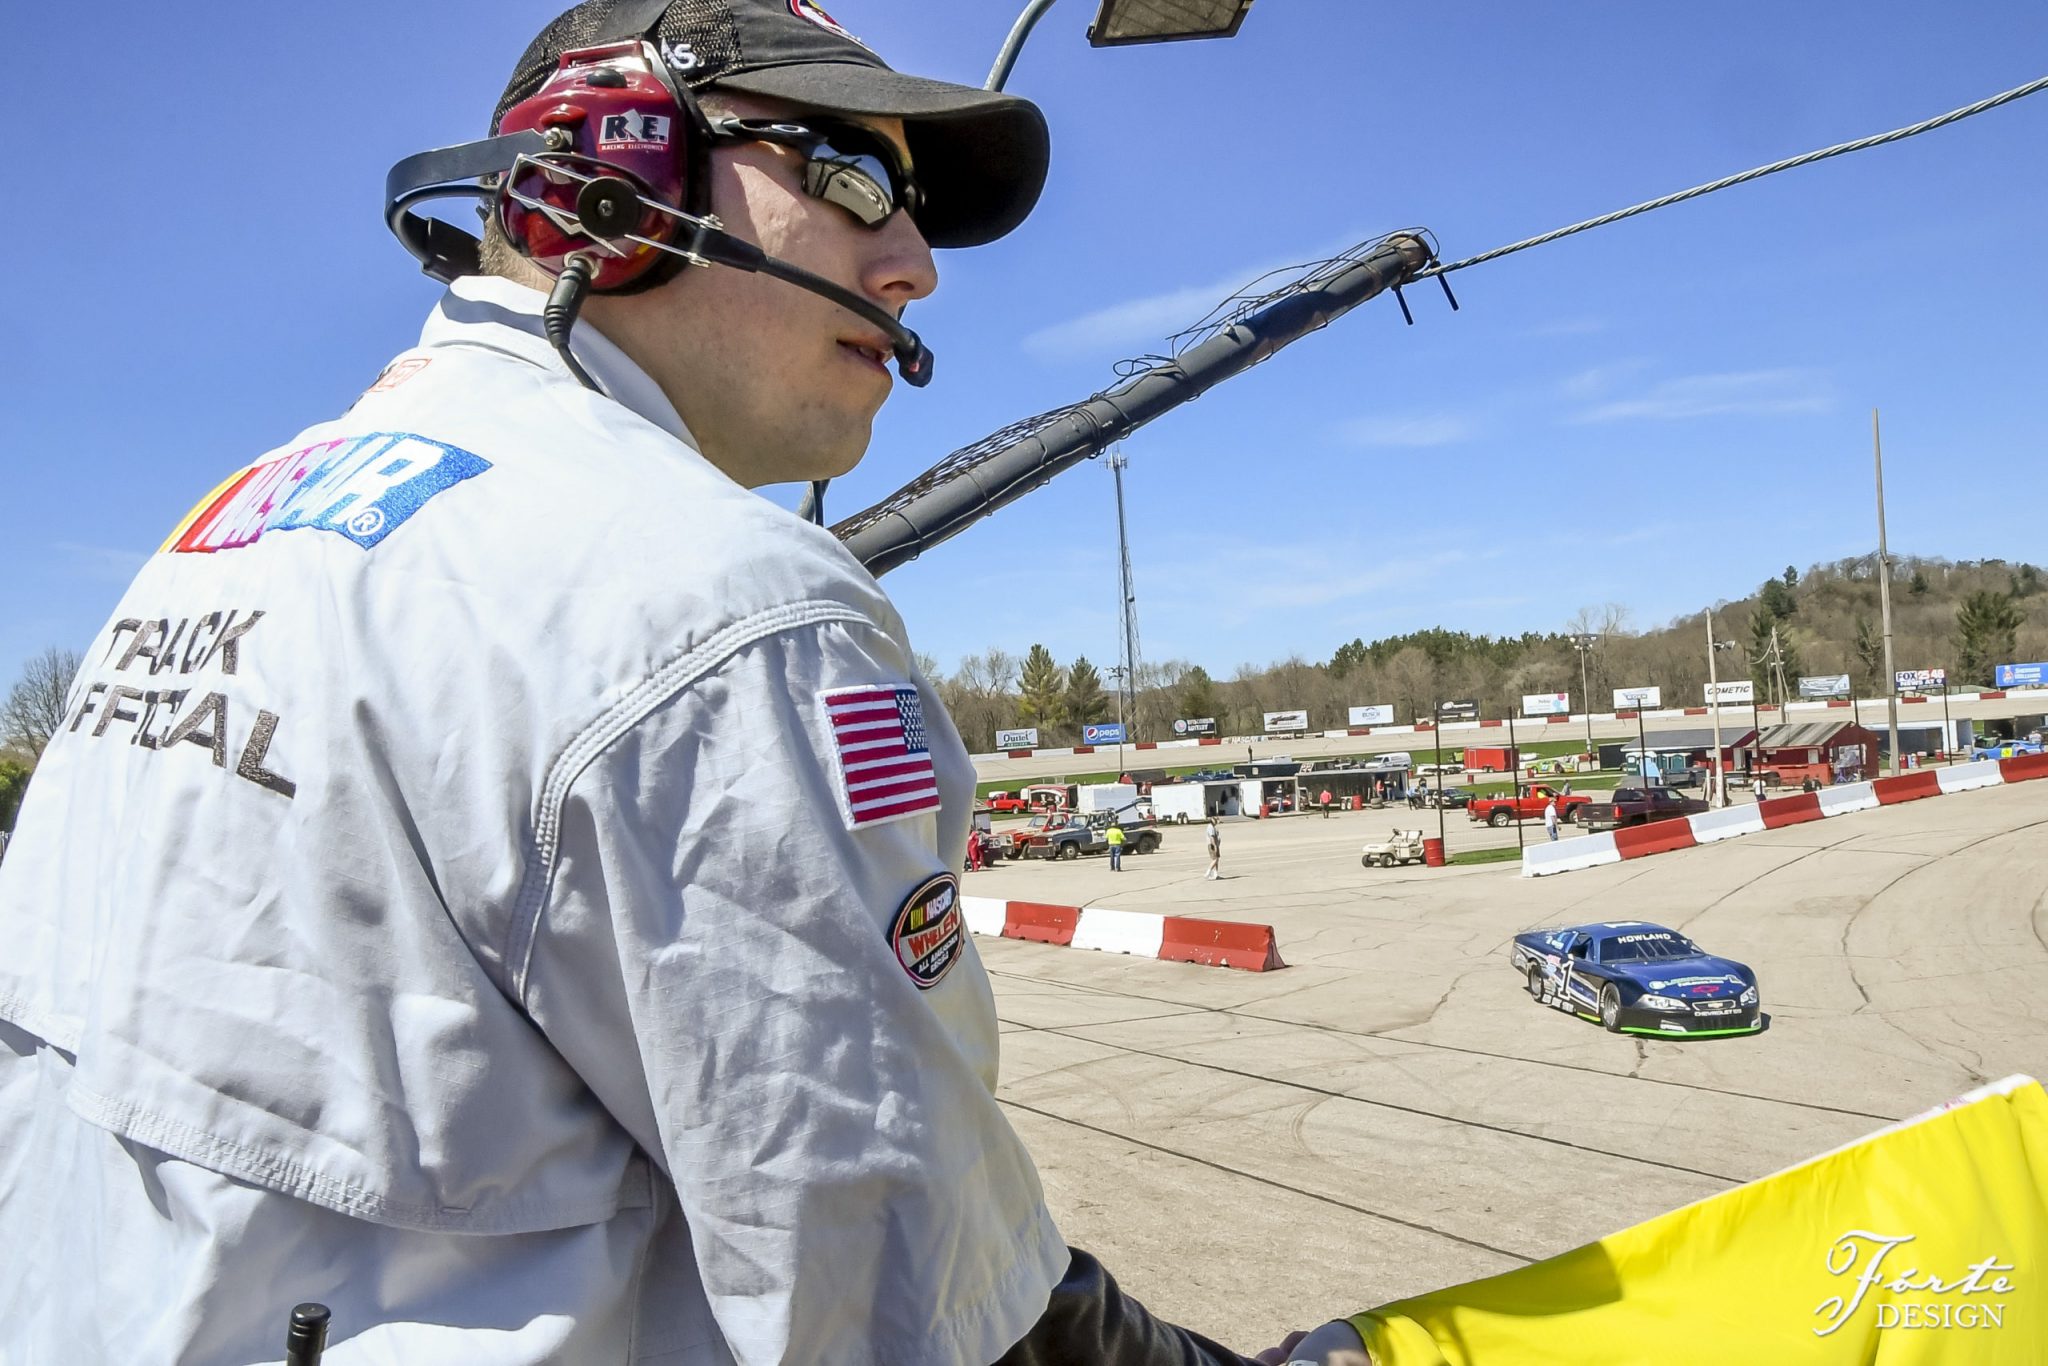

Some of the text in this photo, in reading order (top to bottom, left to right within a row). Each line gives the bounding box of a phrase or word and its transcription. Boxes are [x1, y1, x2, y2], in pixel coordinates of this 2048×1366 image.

[601, 143, 625, 151] RACING
[1896, 672, 1917, 681] FOX
[1707, 685, 1750, 695] COMETIC
[1099, 728, 1120, 738] peps
[1617, 932, 1672, 944] HOWLAND
[918, 958, 930, 974] ALL
[1558, 958, 1575, 1000] 1
